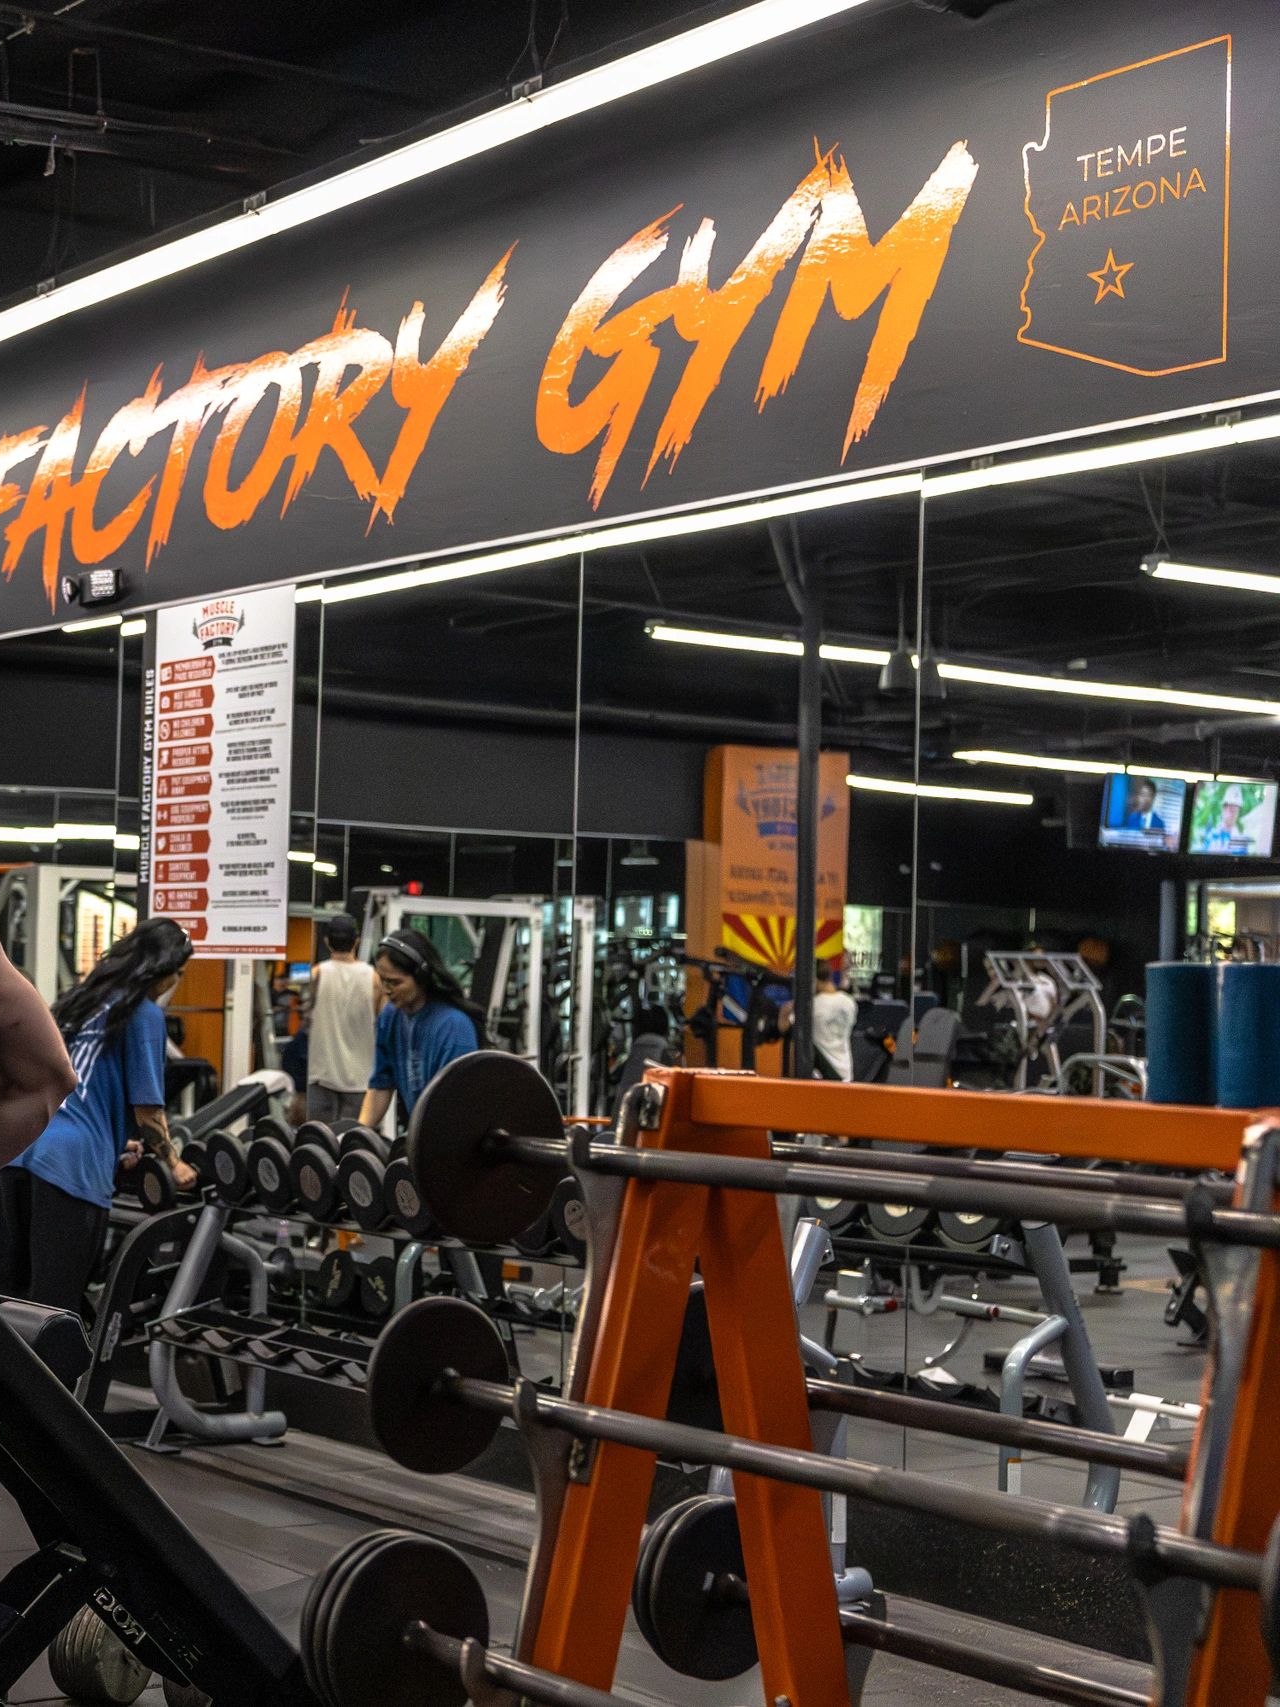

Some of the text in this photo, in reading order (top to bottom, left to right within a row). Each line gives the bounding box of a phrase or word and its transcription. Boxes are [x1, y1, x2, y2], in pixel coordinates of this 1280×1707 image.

[1076, 125, 1188, 182] TEMPE
[1057, 167, 1207, 231] ARIZONA
[535, 135, 979, 512] GYM
[200, 622, 236, 640] FACTORY
[202, 600, 235, 618] MUSCLE
[140, 669, 155, 883] MUSCLE FACTORY GYM RULES
